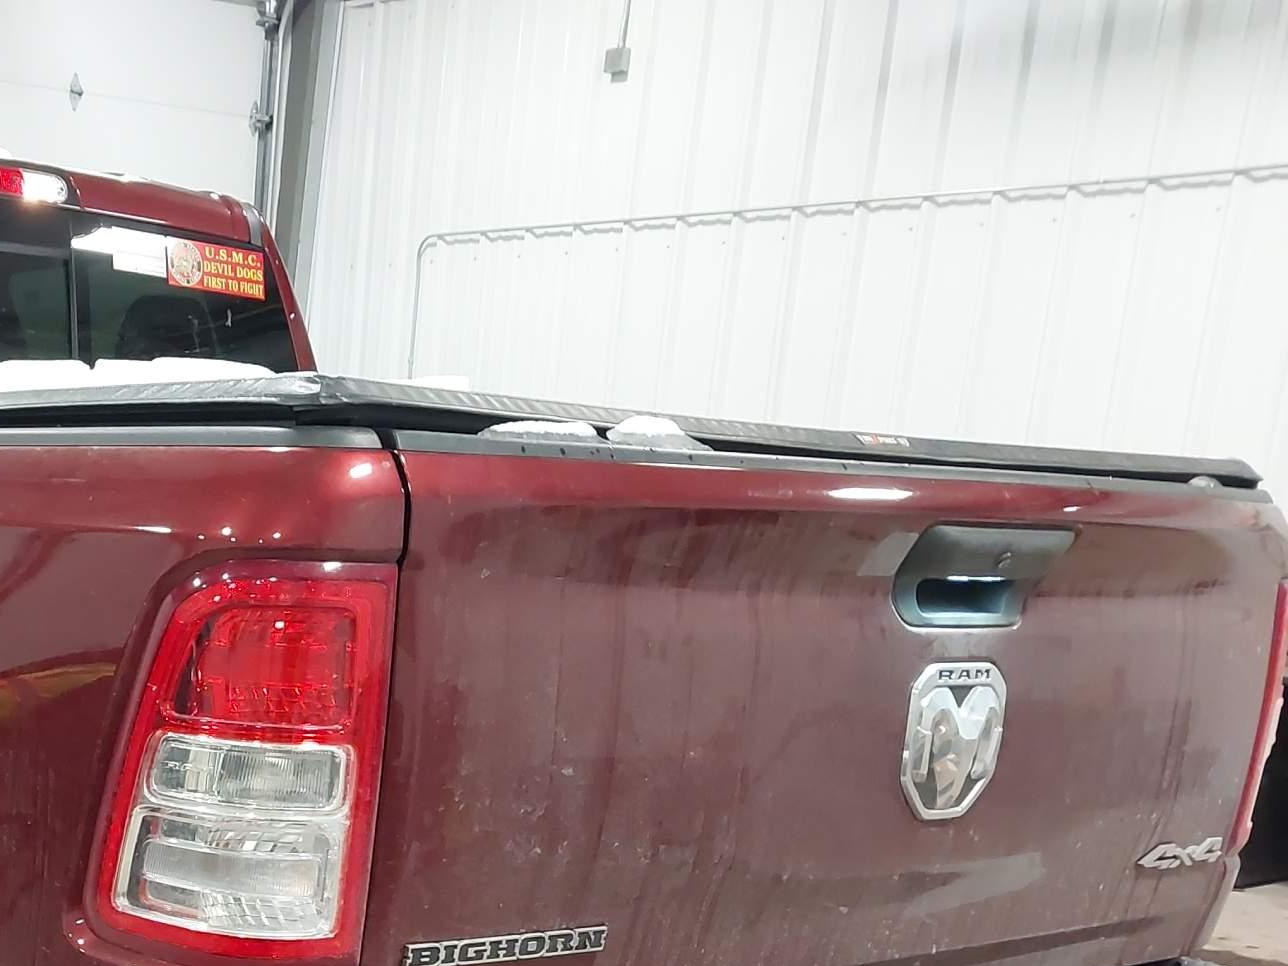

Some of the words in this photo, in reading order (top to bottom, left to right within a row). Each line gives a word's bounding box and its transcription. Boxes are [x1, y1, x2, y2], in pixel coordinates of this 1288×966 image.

[204, 246, 261, 267] U.S.M.C.
[203, 261, 235, 277] DEVIL
[236, 266, 263, 282] DOGS
[203, 275, 226, 290] FIRST
[228, 280, 239, 292] TO
[240, 281, 264, 297] FIGHT
[938, 668, 992, 681] RAM
